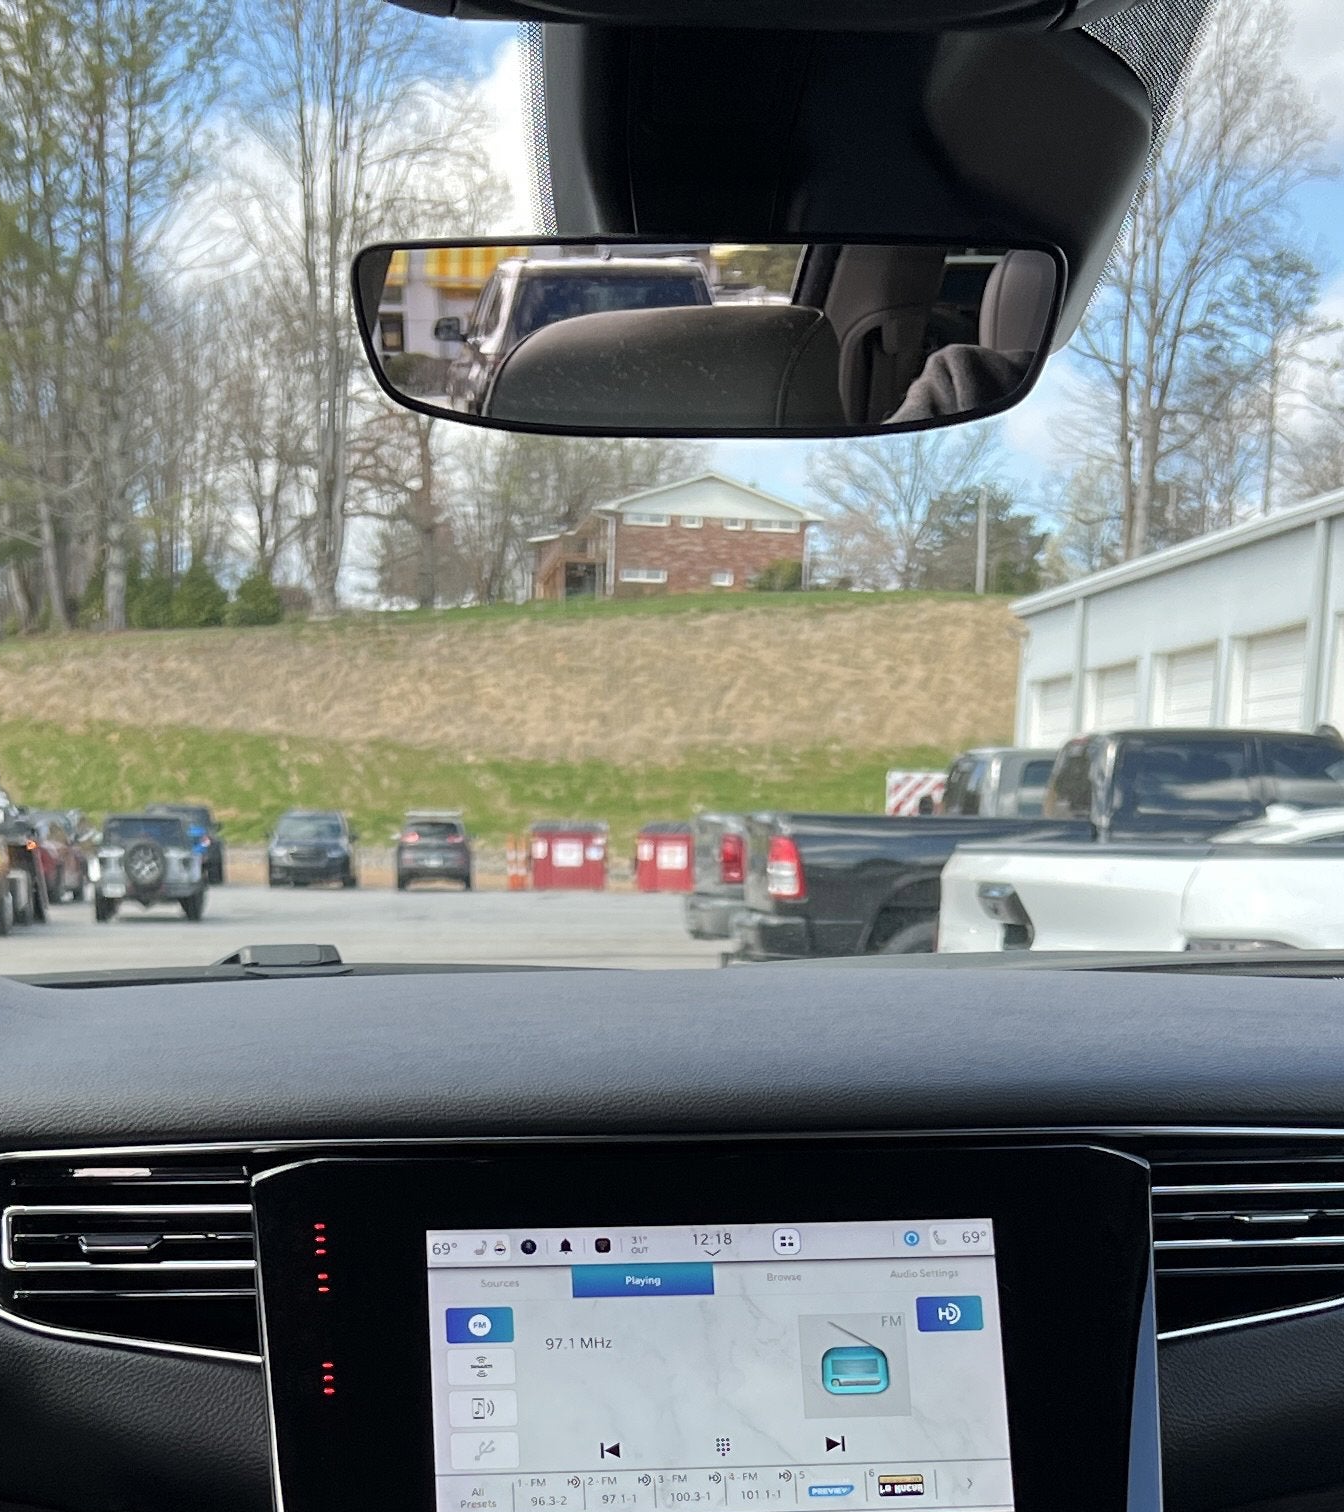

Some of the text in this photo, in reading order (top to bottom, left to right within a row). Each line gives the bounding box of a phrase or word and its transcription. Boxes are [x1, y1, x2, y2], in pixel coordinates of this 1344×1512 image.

[631, 1235, 648, 1245] 31°
[692, 1233, 733, 1246] 12:18
[962, 1229, 988, 1244] 69°
[431, 1242, 458, 1256] 69°
[631, 1246, 649, 1255] OUT
[766, 1272, 802, 1282] Browse
[889, 1268, 959, 1279] Audio Settings
[480, 1279, 520, 1288] Sources
[625, 1275, 661, 1286] Playing
[473, 1321, 487, 1330] FM
[881, 1315, 903, 1328] FM
[545, 1337, 612, 1350] 97.1 MHz
[658, 1475, 665, 1484] 3
[672, 1474, 688, 1483] FM
[742, 1472, 759, 1481] FM
[799, 1470, 806, 1479] 5
[868, 1470, 875, 1478] 6
[530, 1478, 547, 1487] FM
[587, 1477, 594, 1486] 2
[601, 1475, 618, 1485] FM
[472, 1487, 485, 1497] All
[670, 1490, 711, 1502] 100.3-1
[741, 1489, 782, 1500] 101.1-1
[460, 1499, 497, 1509] Presets
[530, 1495, 568, 1507] 96.3-2
[602, 1493, 638, 1505] 97.1-1
